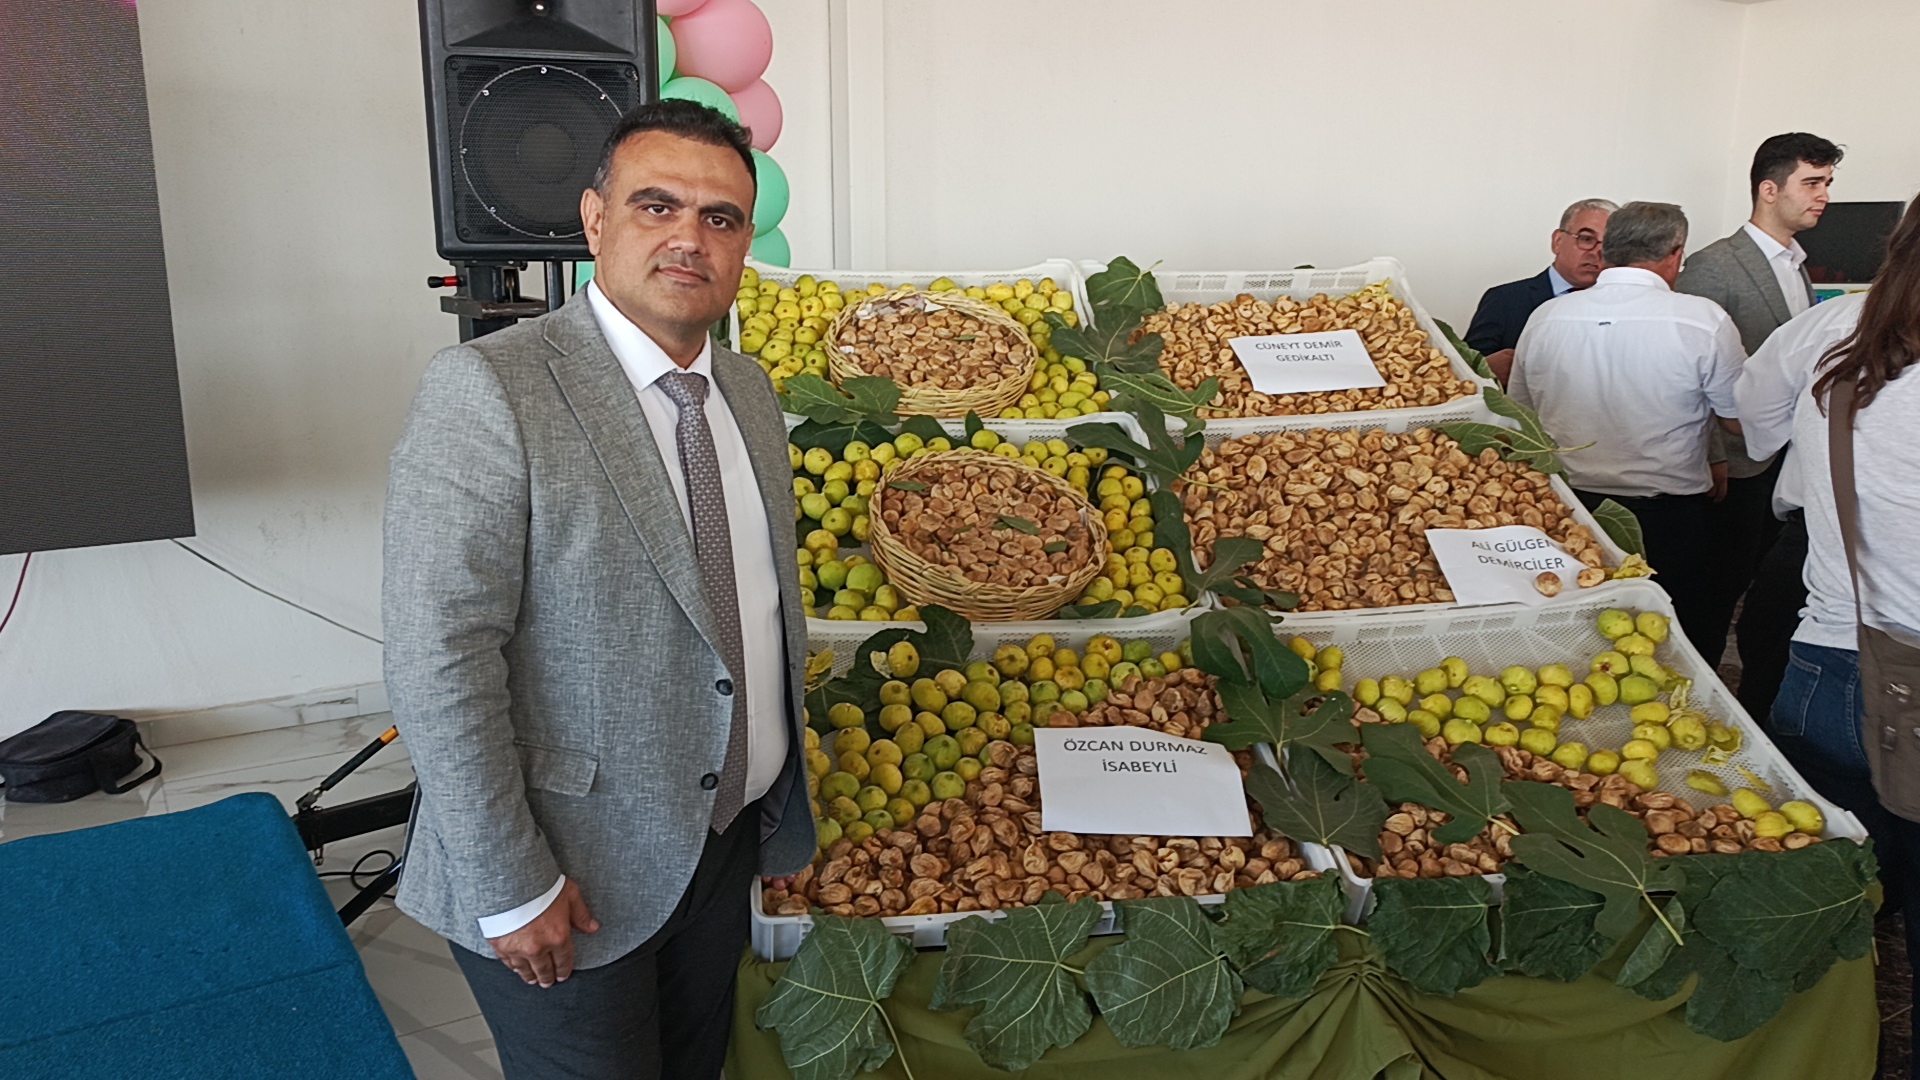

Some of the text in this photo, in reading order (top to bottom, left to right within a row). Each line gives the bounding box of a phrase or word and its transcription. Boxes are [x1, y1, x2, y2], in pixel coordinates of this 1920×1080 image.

[1255, 340, 1343, 351] CÜNEYT DEMİR
[1276, 353, 1335, 362] GEDİKALTI
[1471, 539, 1491, 551] ALİ
[1477, 554, 1565, 571] DEMİRCİLER
[1063, 738, 1208, 755] ÖZCAN DURMAZ
[1102, 759, 1177, 773] İSABEYLİ
